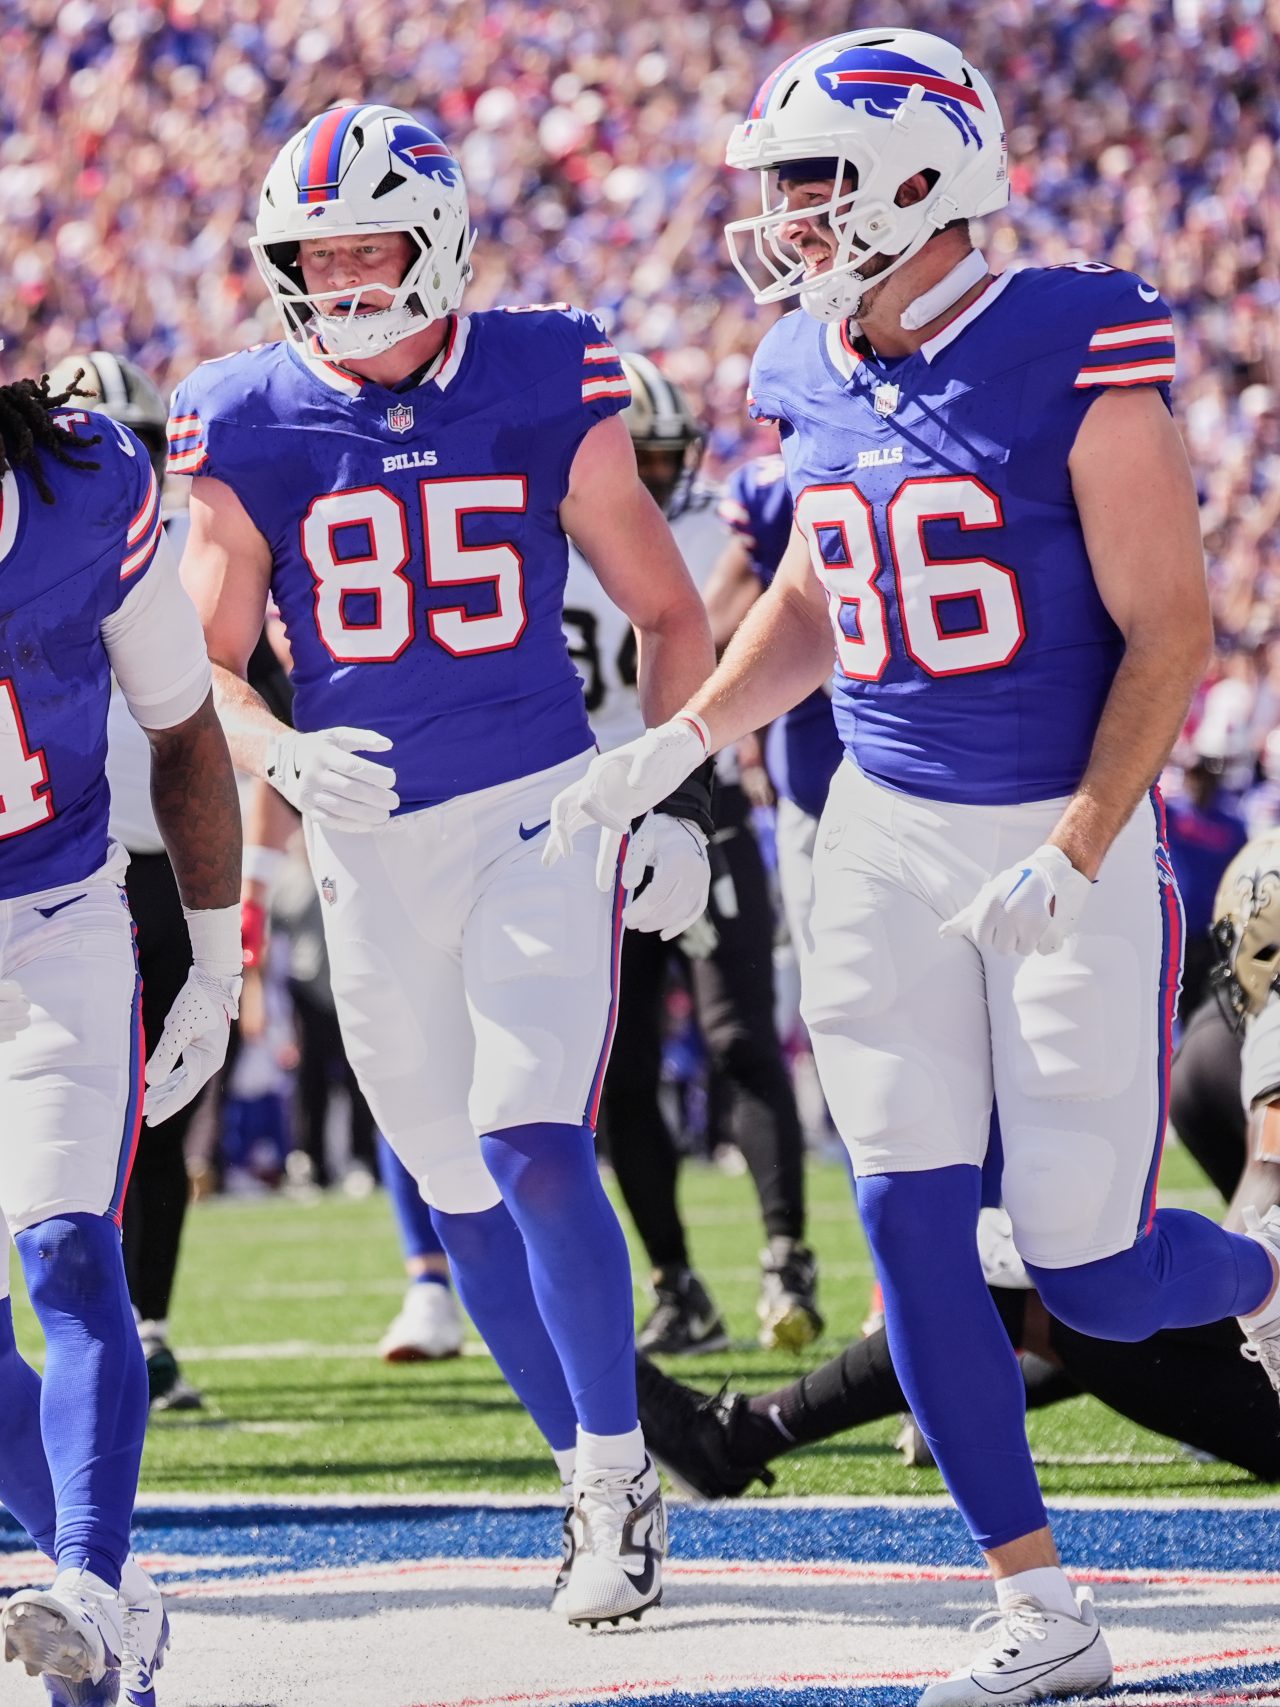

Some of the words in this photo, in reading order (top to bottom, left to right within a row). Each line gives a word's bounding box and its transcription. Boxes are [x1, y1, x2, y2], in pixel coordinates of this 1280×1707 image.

[382, 450, 438, 473] BILLS
[857, 447, 904, 469] BILLS
[298, 474, 529, 664] 85
[794, 472, 1027, 683] 86
